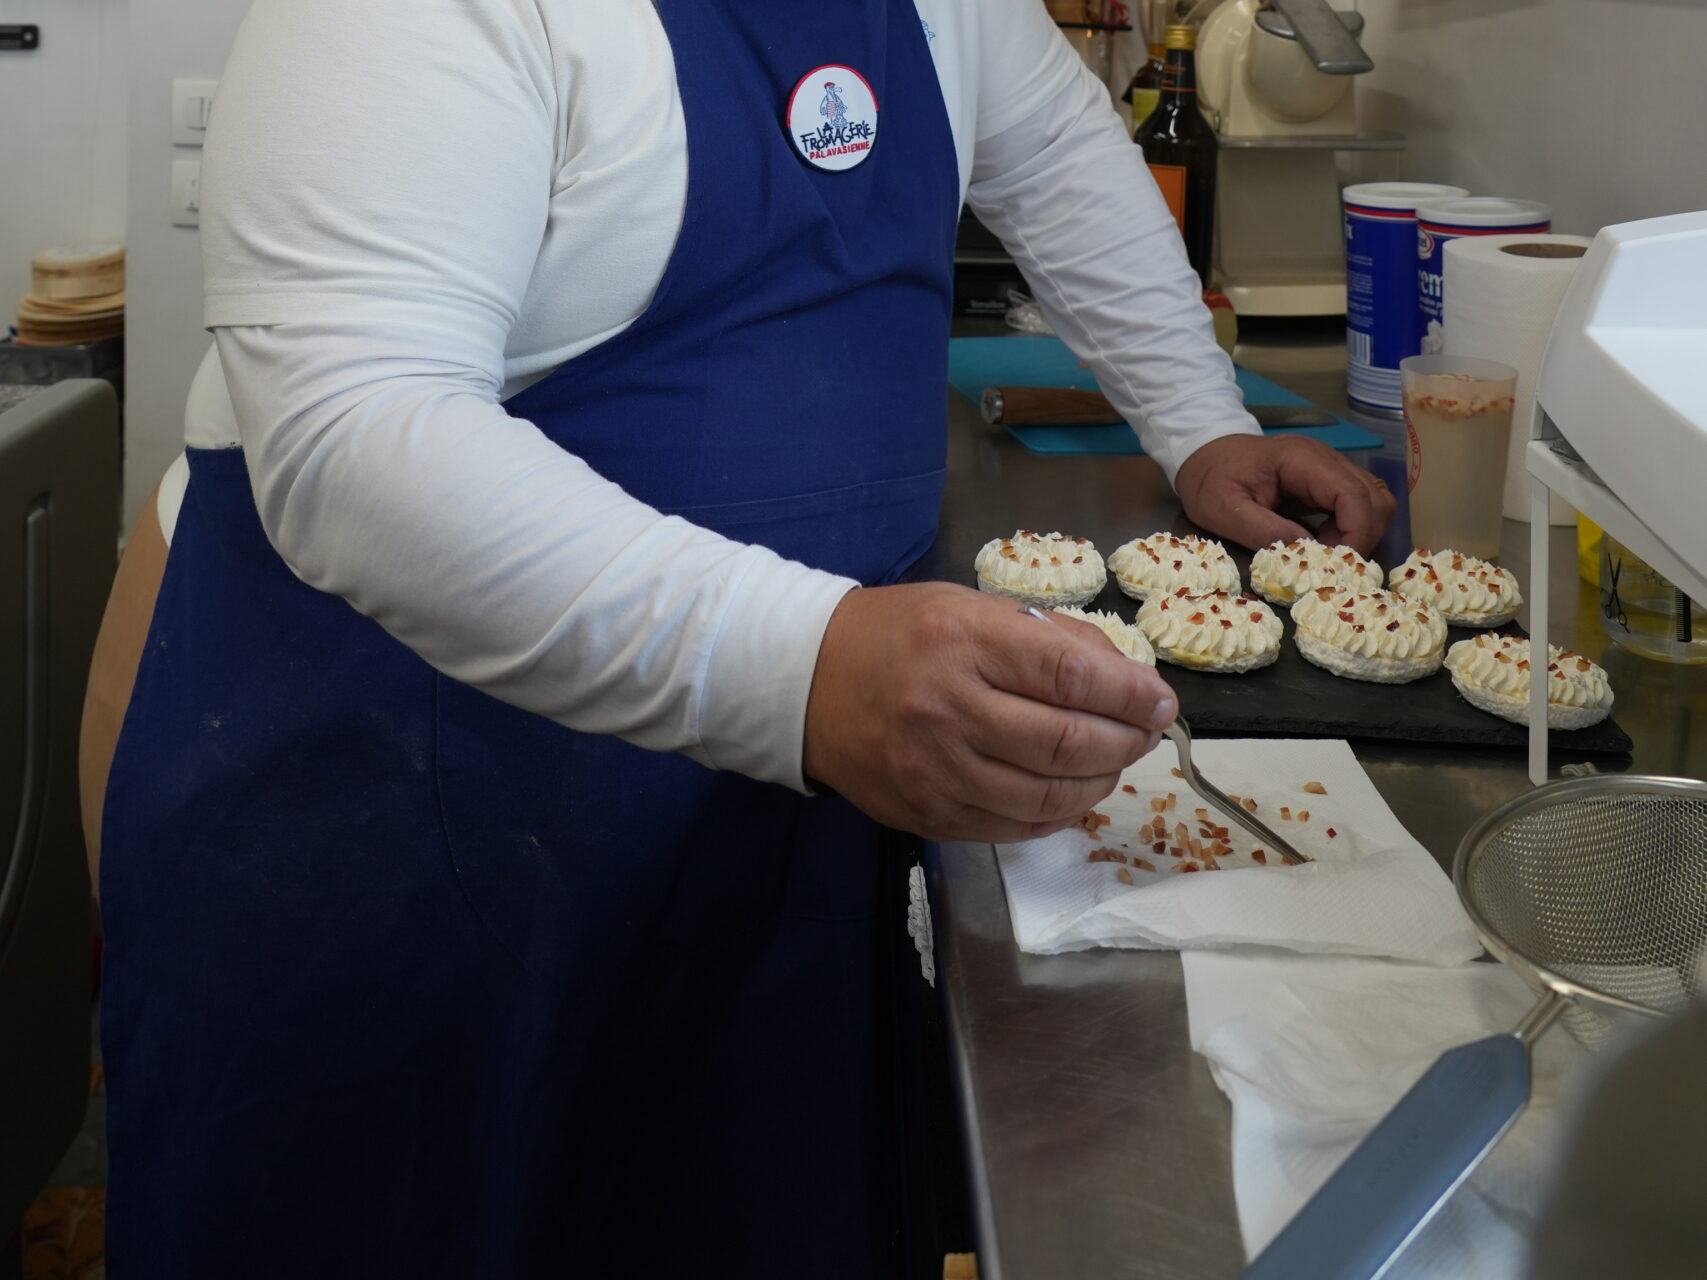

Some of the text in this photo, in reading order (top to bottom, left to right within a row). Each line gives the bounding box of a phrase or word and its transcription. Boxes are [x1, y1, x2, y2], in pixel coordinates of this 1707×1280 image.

[800, 120, 875, 153] FROMAGERIE
[816, 121, 834, 139] LA
[809, 140, 871, 160] PALAVASIENNE
